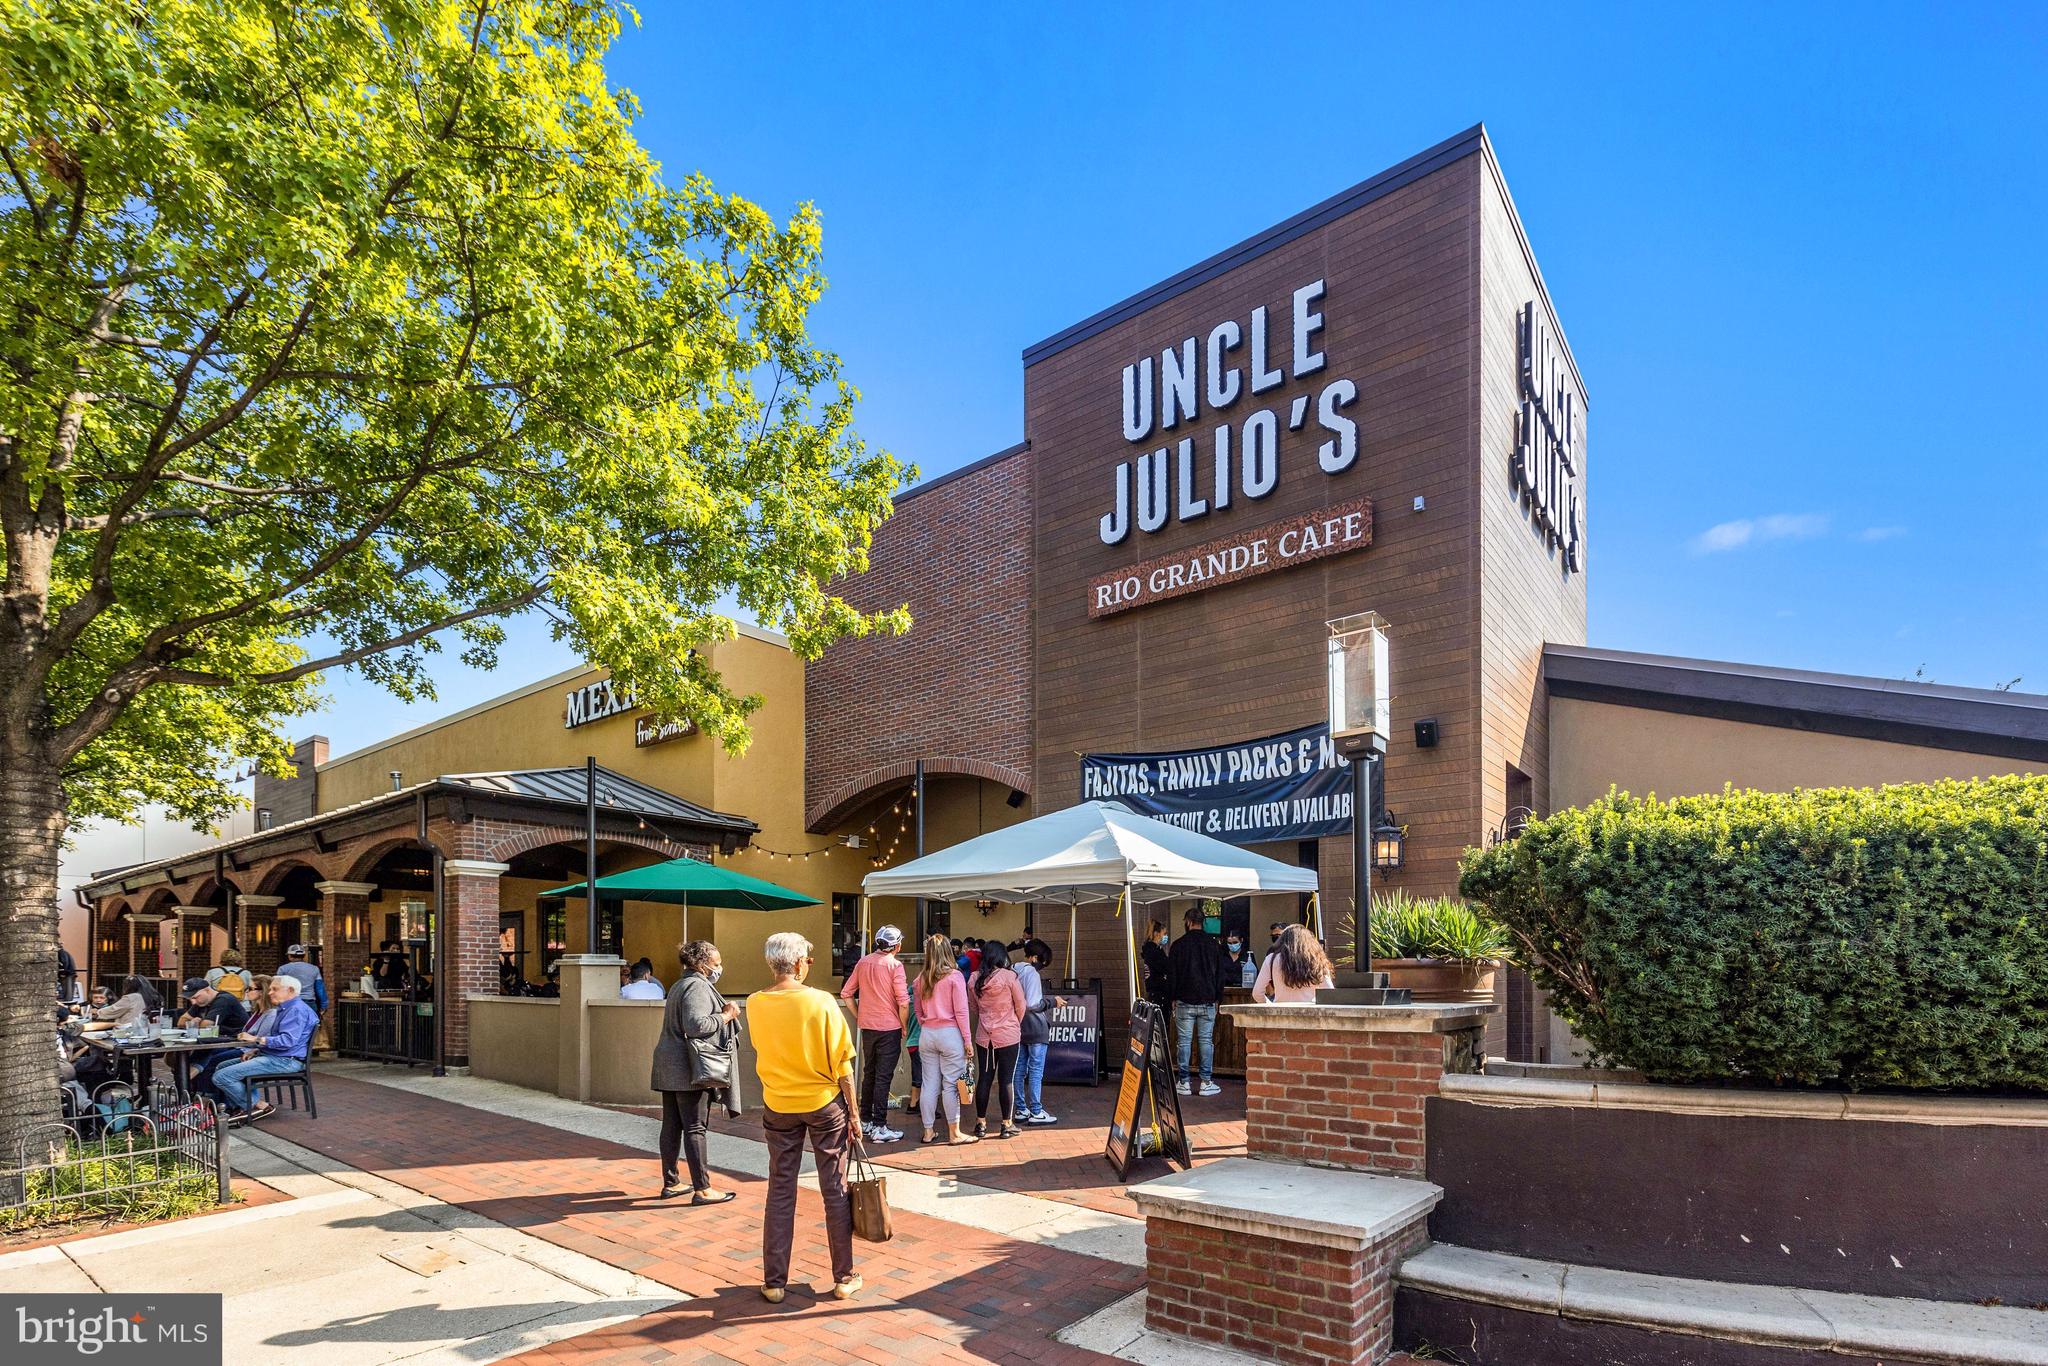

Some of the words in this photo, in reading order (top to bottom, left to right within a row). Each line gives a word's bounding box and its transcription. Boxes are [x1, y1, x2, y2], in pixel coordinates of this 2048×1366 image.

[1122, 278, 1327, 444] UNCLE
[1099, 378, 1360, 546] JULIO'S
[1096, 575, 1141, 610] RIO
[1149, 539, 1268, 594] GRANDE
[1278, 511, 1363, 558] CAFE
[1084, 761, 1155, 799] FAJITAS,
[1158, 752, 1223, 792] FAMILY
[1228, 741, 1292, 782] PACKS
[1298, 737, 1313, 773] &
[1206, 808, 1222, 833] &
[1224, 800, 1289, 832] DELIVERY
[1292, 791, 1354, 825] AVAILAB
[1048, 1026, 1096, 1043] HECK-IN
[1052, 1005, 1086, 1023] PATIO
